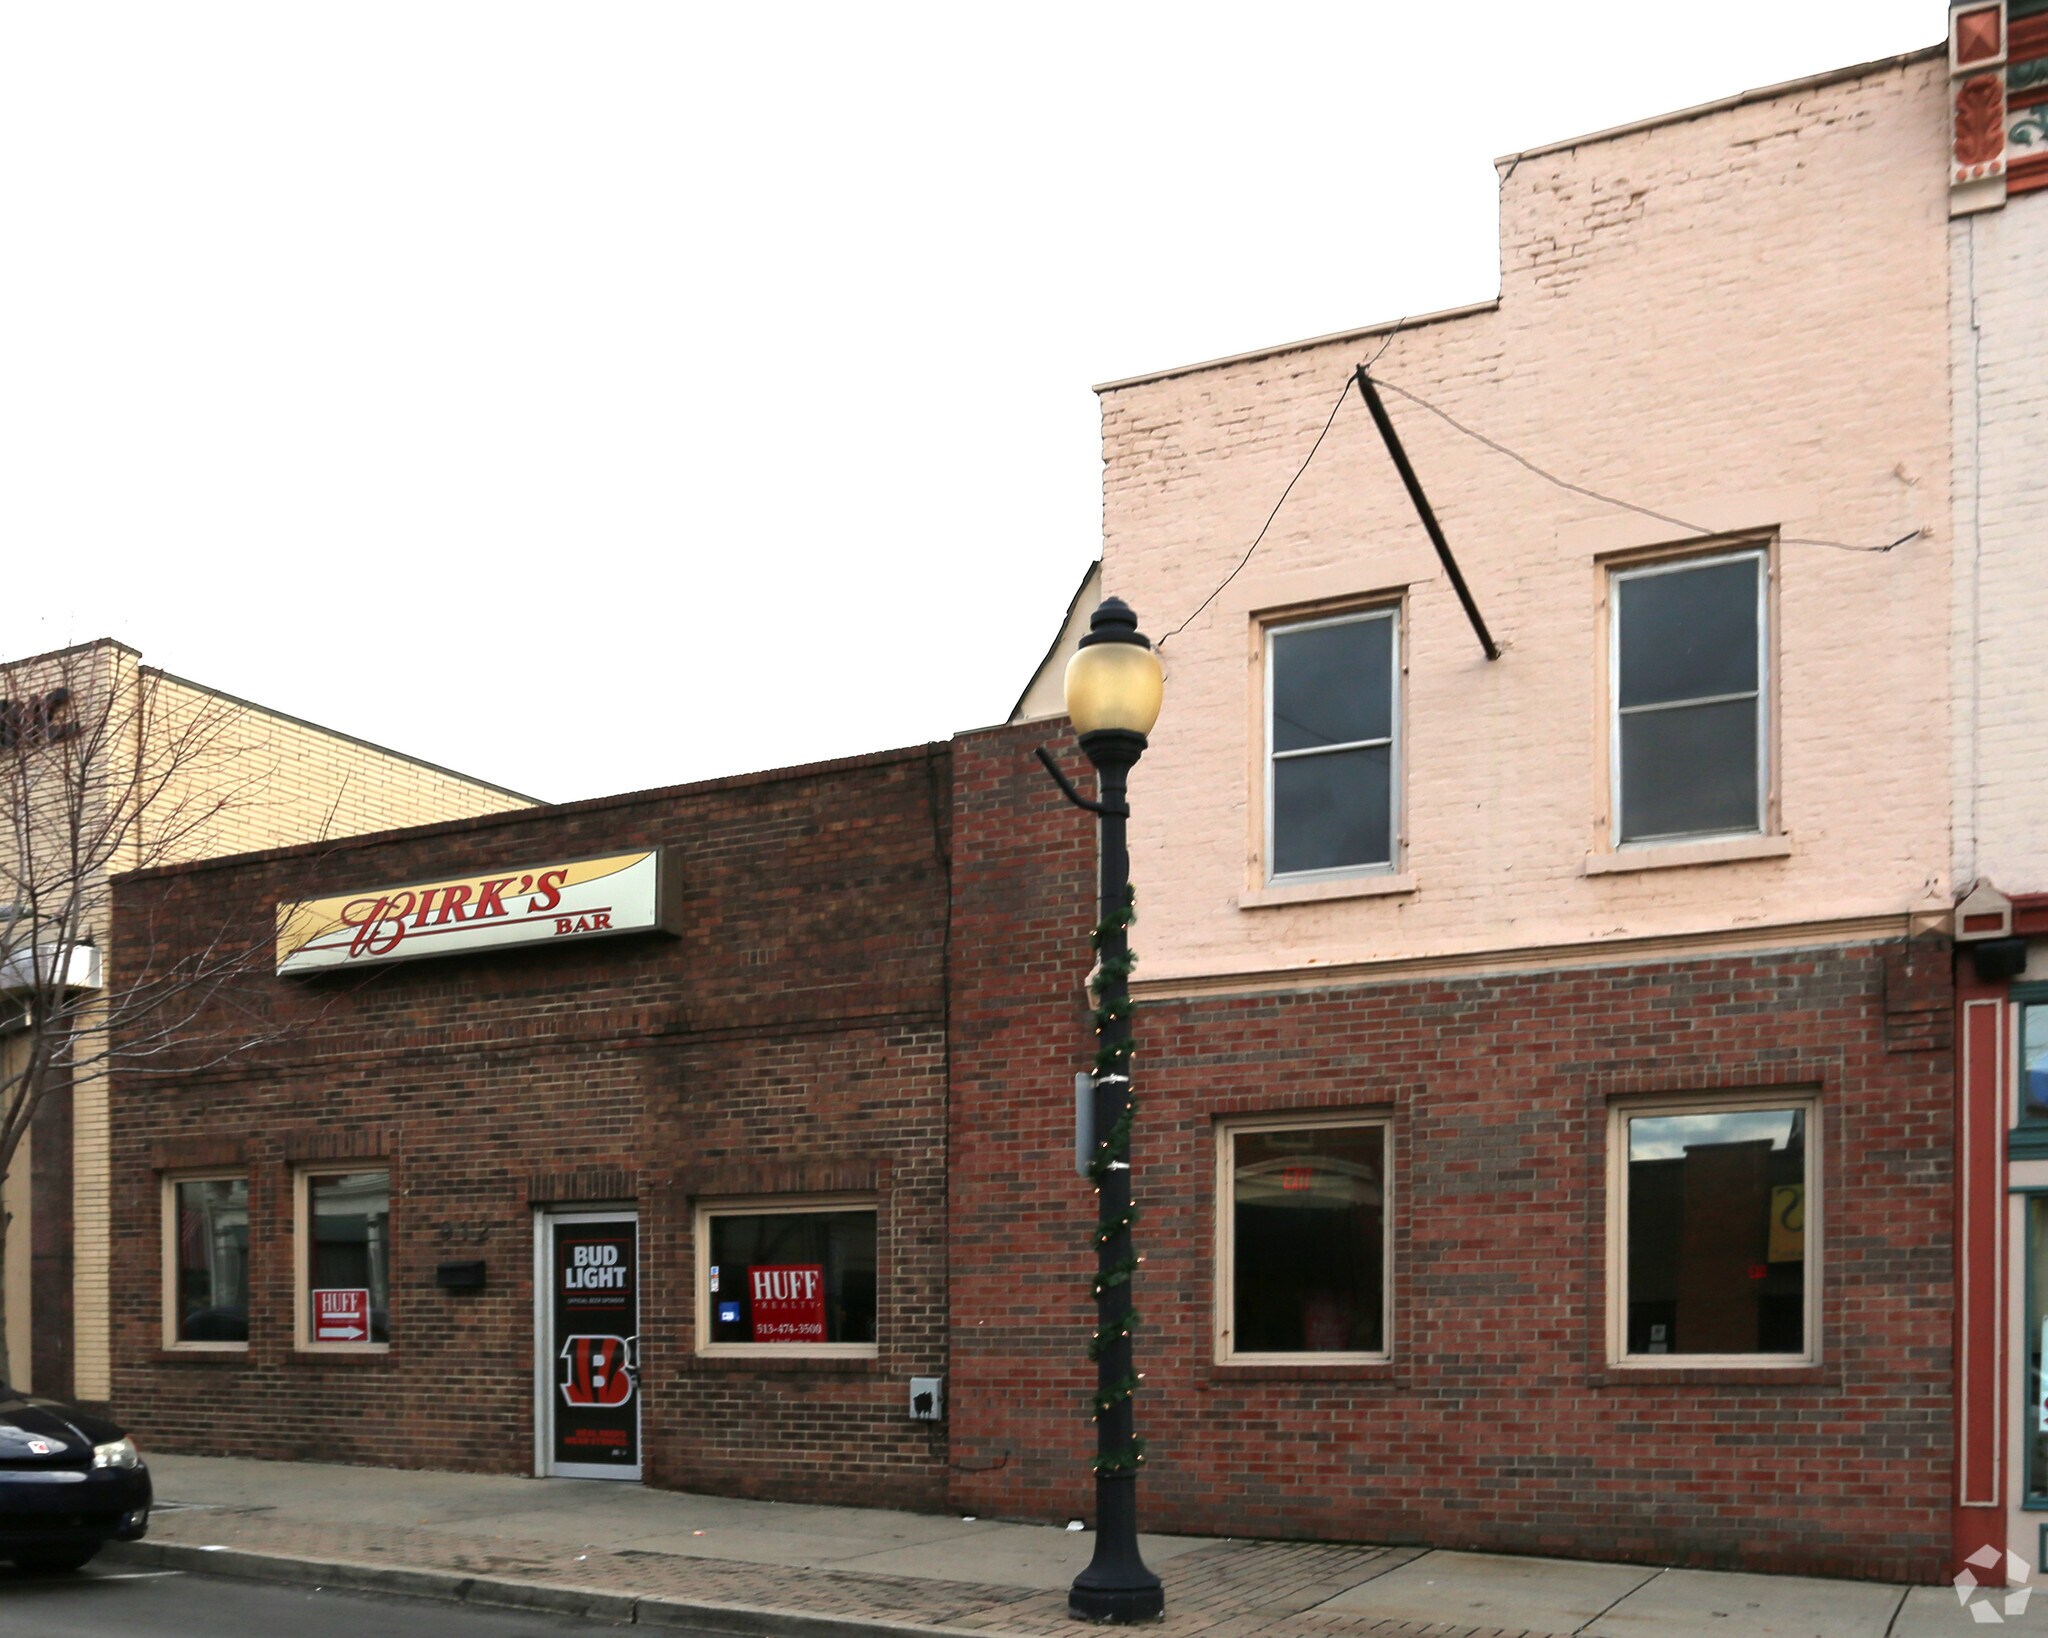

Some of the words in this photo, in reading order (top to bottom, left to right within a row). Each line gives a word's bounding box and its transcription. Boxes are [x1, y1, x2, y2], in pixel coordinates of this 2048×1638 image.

[340, 868, 569, 959] BIRK'S
[554, 913, 614, 936] BAR
[573, 1245, 619, 1267] BUD
[565, 1267, 627, 1289] LIGHT
[752, 1270, 819, 1300] HUFF
[321, 1292, 360, 1312] HUFF
[761, 1301, 815, 1310] REALTY
